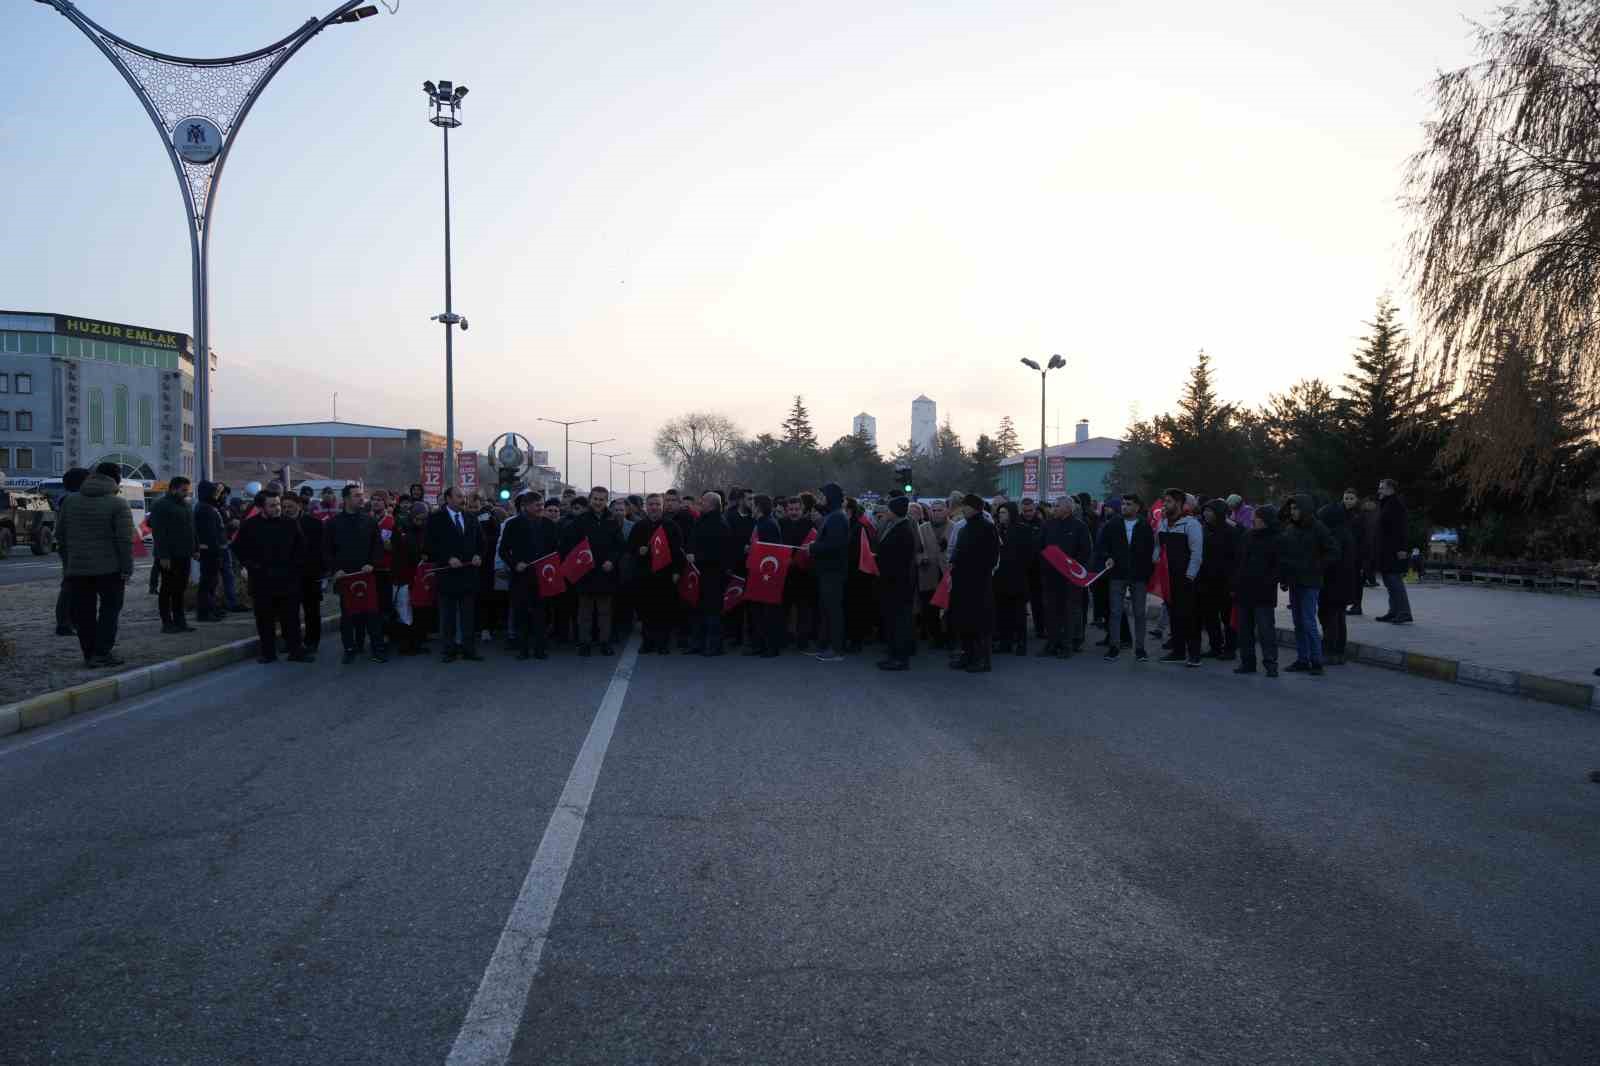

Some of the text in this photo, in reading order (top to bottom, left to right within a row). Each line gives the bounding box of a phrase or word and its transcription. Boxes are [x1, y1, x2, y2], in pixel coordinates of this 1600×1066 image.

[67, 319, 121, 337] HUZUR
[126, 328, 177, 345] EMLAK
[426, 472, 440, 485] 12
[461, 473, 475, 486] 12
[1024, 473, 1037, 484] 12
[1050, 473, 1064, 484] 12
